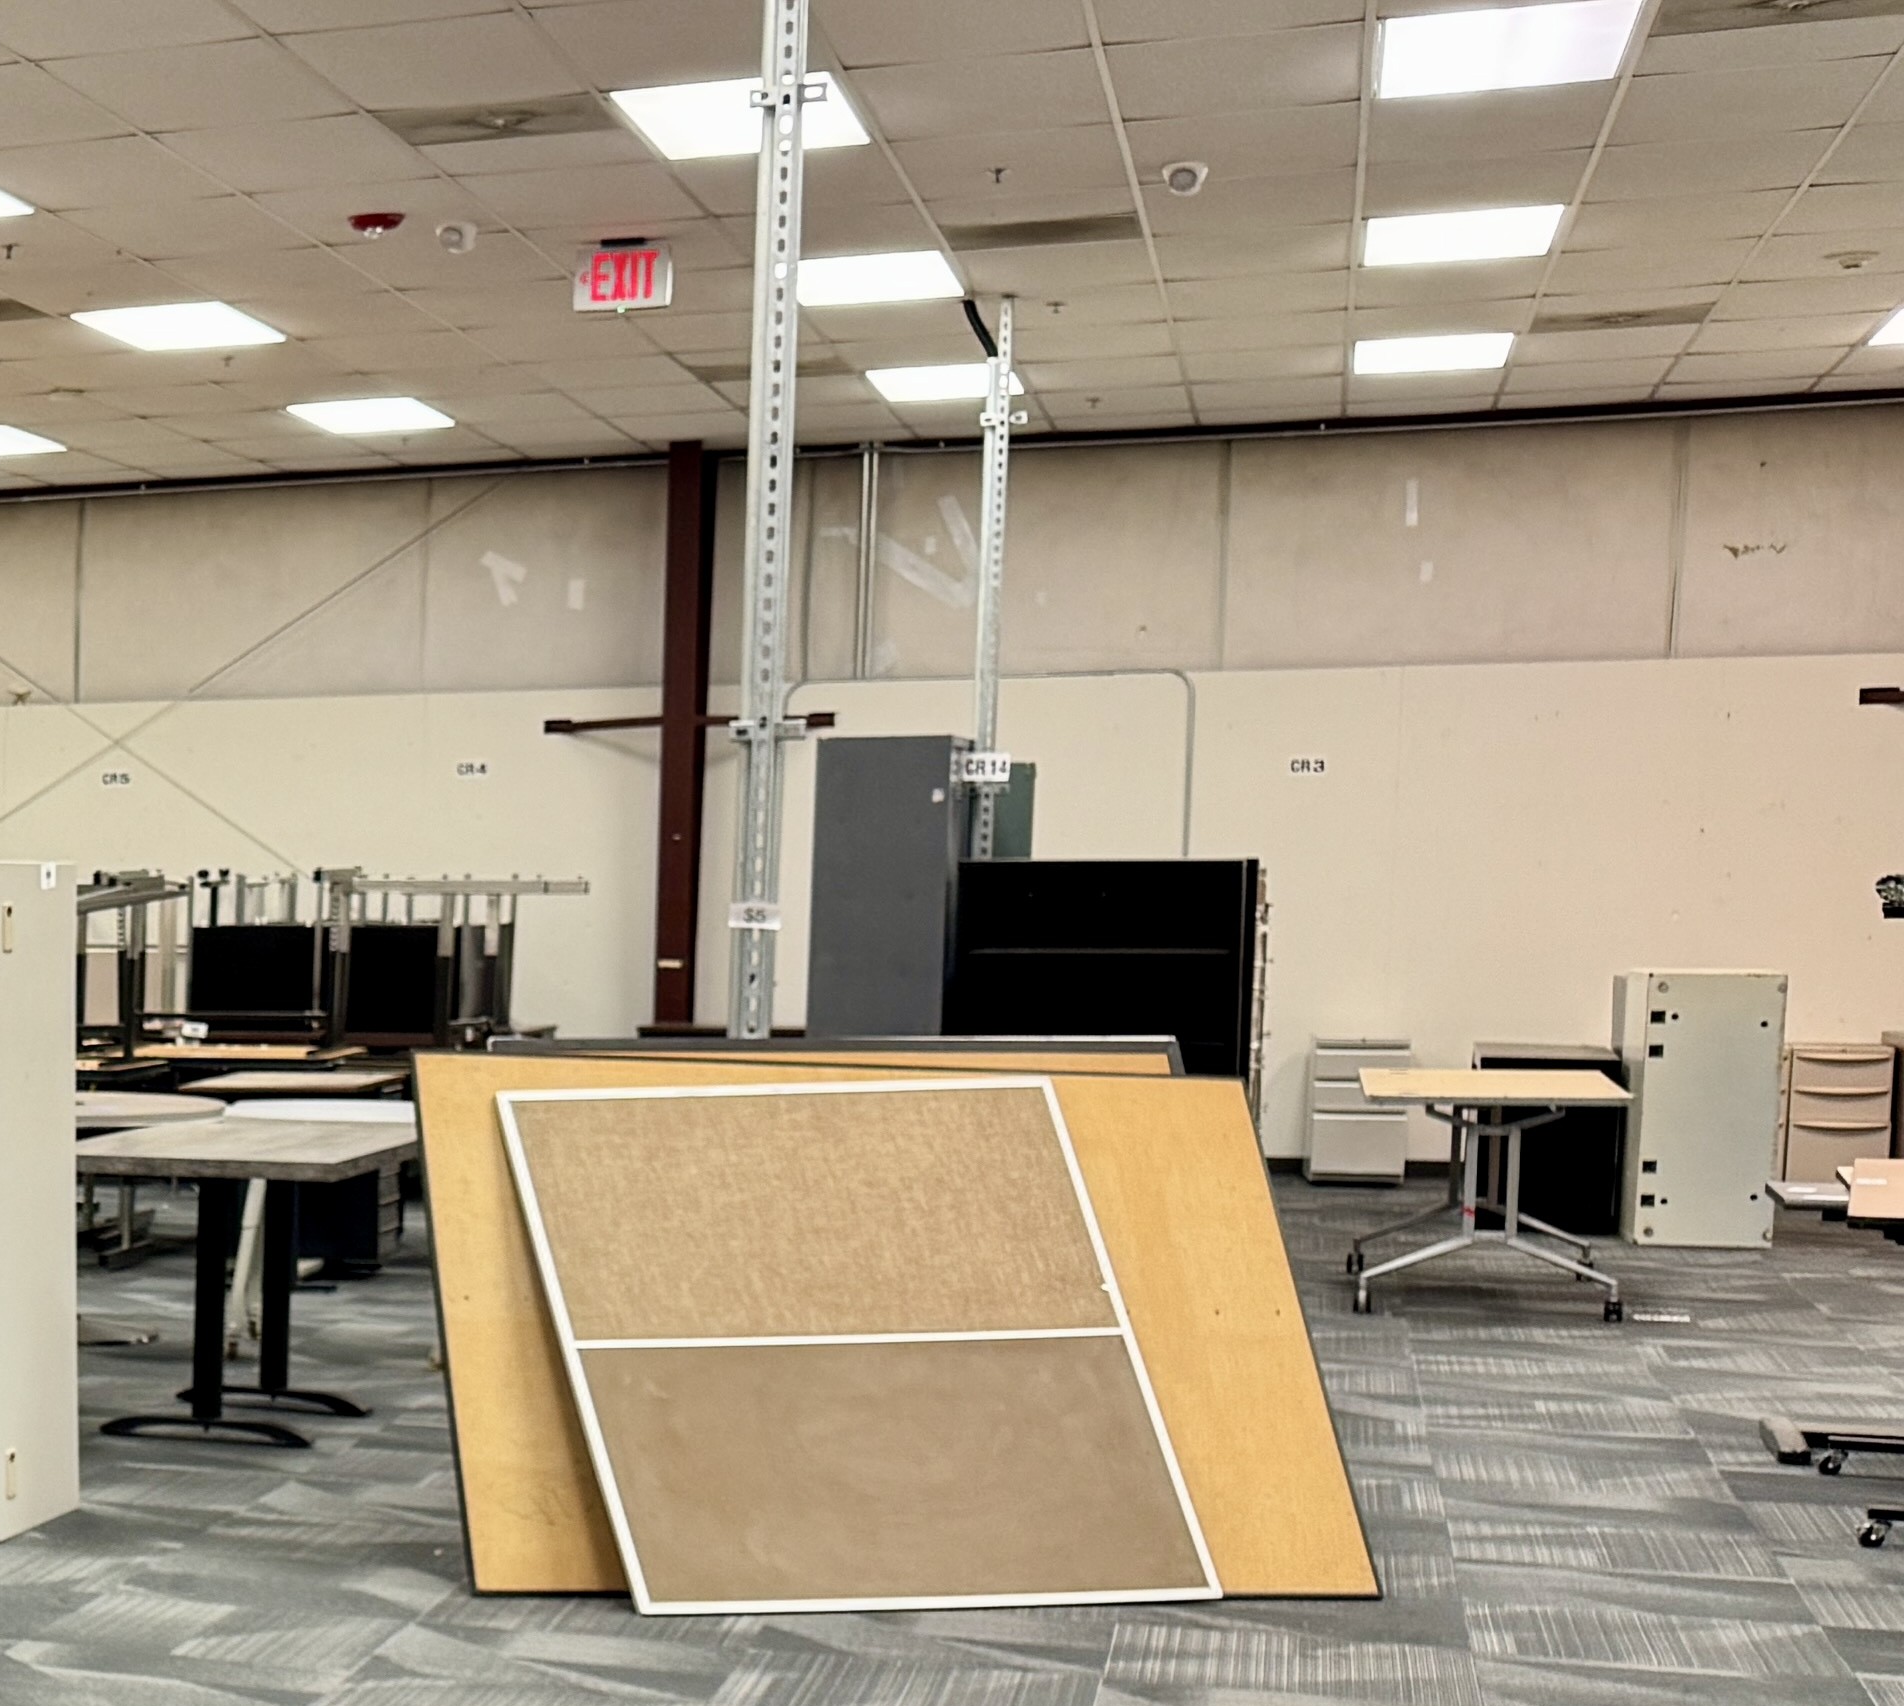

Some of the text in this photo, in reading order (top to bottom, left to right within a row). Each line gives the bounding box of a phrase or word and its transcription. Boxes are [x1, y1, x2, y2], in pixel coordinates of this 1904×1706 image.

[591, 250, 659, 301] EXIT
[965, 758, 986, 775] CR
[1290, 758, 1325, 773] CR 3
